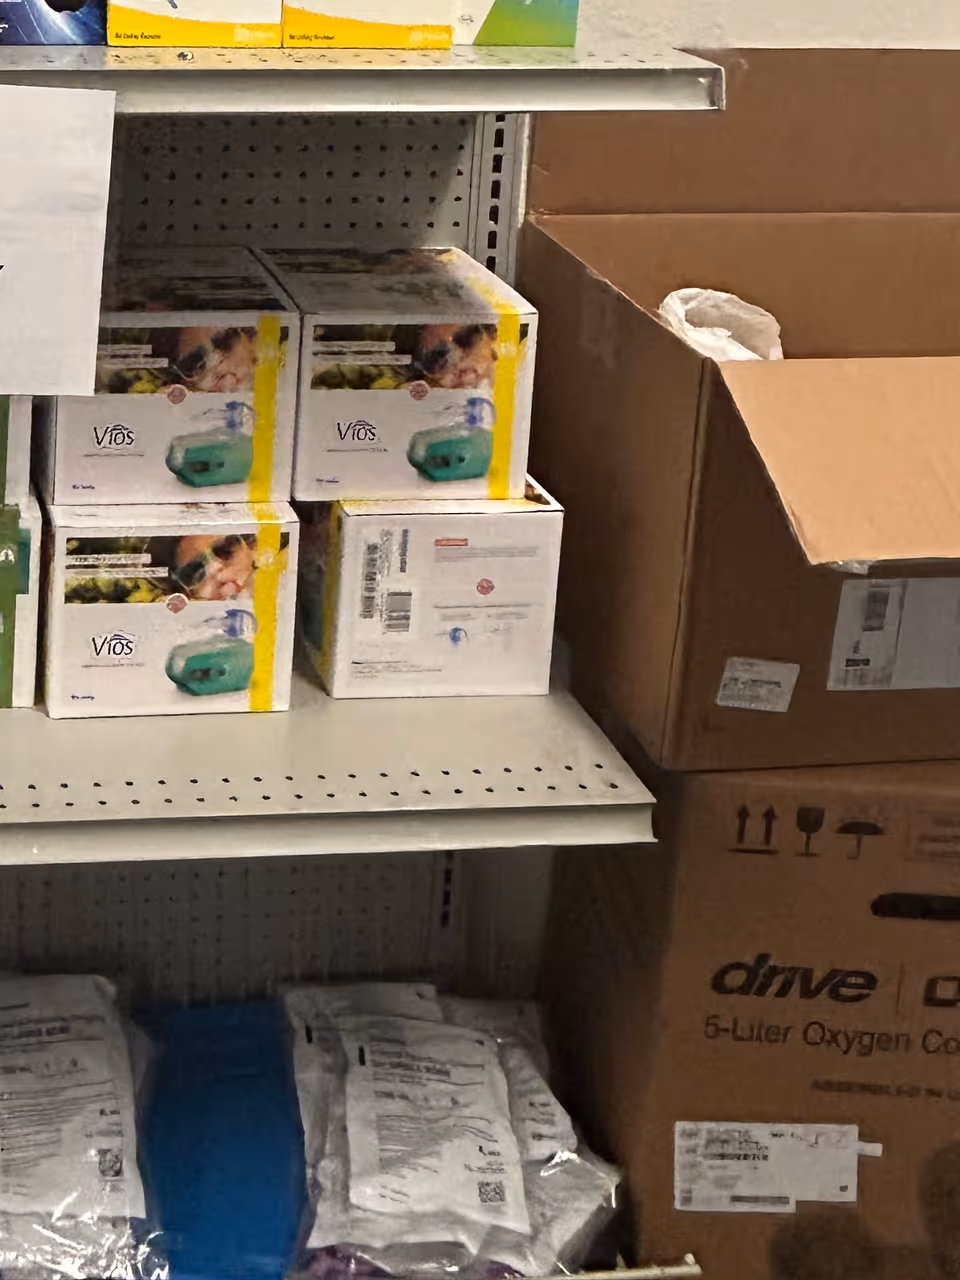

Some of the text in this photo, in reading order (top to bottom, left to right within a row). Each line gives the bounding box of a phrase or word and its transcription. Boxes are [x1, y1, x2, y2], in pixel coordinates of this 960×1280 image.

[93, 424, 136, 448] Vios
[336, 419, 377, 444] Vios
[92, 632, 135, 657] Vios
[711, 953, 878, 1003] drive
[704, 1015, 792, 1043] 5-Liter
[802, 1020, 912, 1057] Oxygen
